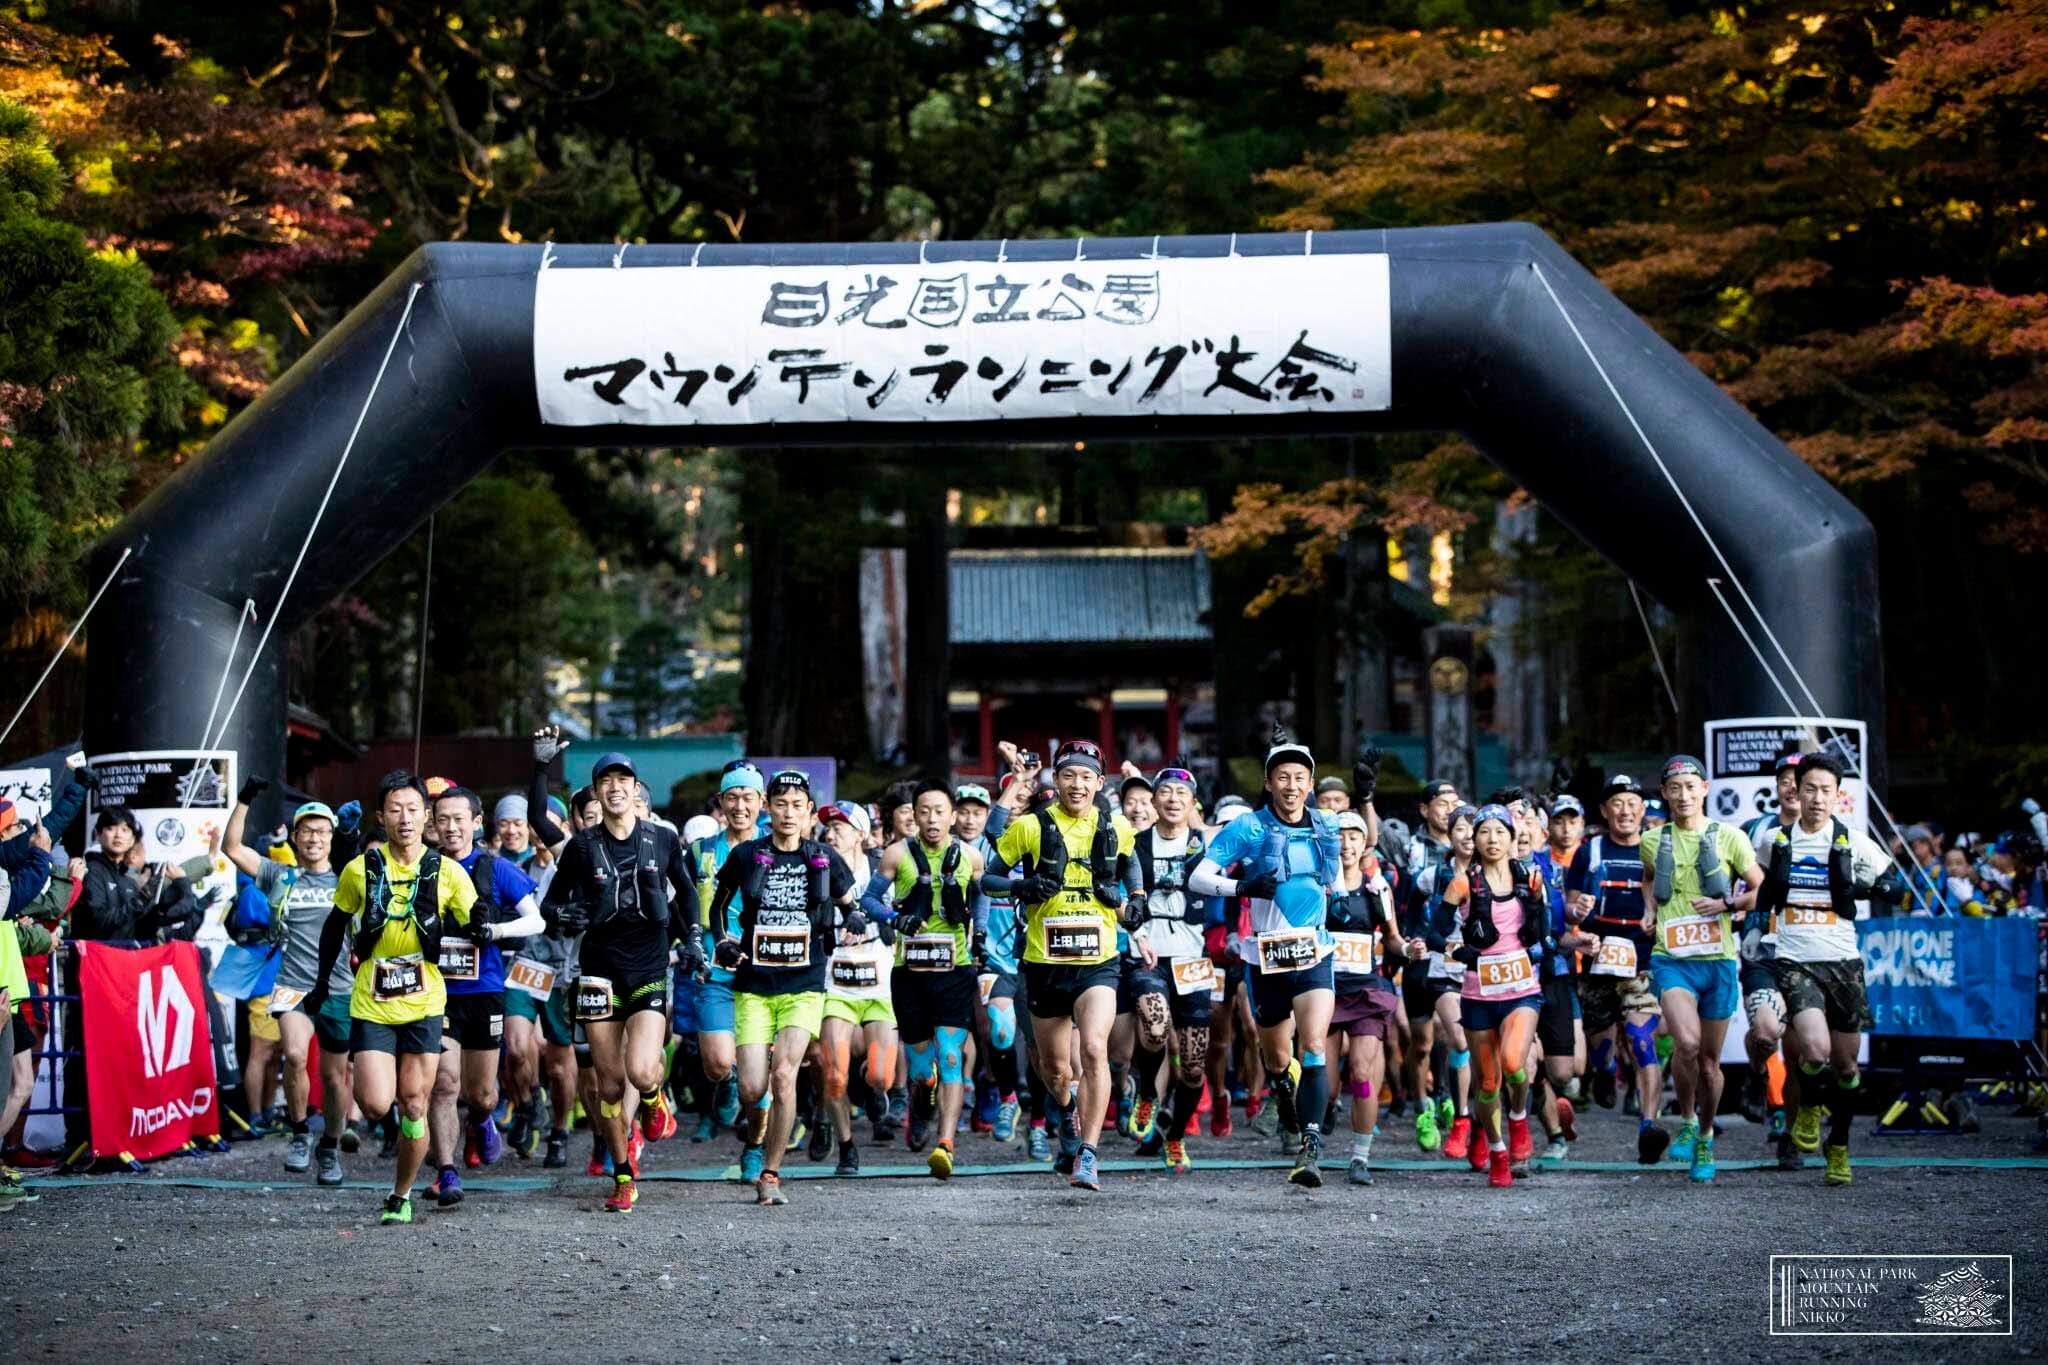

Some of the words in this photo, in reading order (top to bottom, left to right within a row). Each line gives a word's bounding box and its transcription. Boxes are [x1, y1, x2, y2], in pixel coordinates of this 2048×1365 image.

[761, 271, 1160, 328] 日光国立公園
[564, 330, 1357, 410] マウンテンランニング大会
[1728, 730, 1780, 741] NATIONAL
[1728, 741, 1784, 751] MOUNTAIN
[1728, 751, 1775, 761] RUNNING
[144, 763, 172, 774] PARK
[101, 774, 146, 785] MOUNTAIN
[1050, 935, 1073, 948] 上田
[1675, 924, 1711, 946] 828
[1266, 947, 1289, 960] 小川
[516, 966, 545, 988] 178
[1489, 961, 1524, 983] 830
